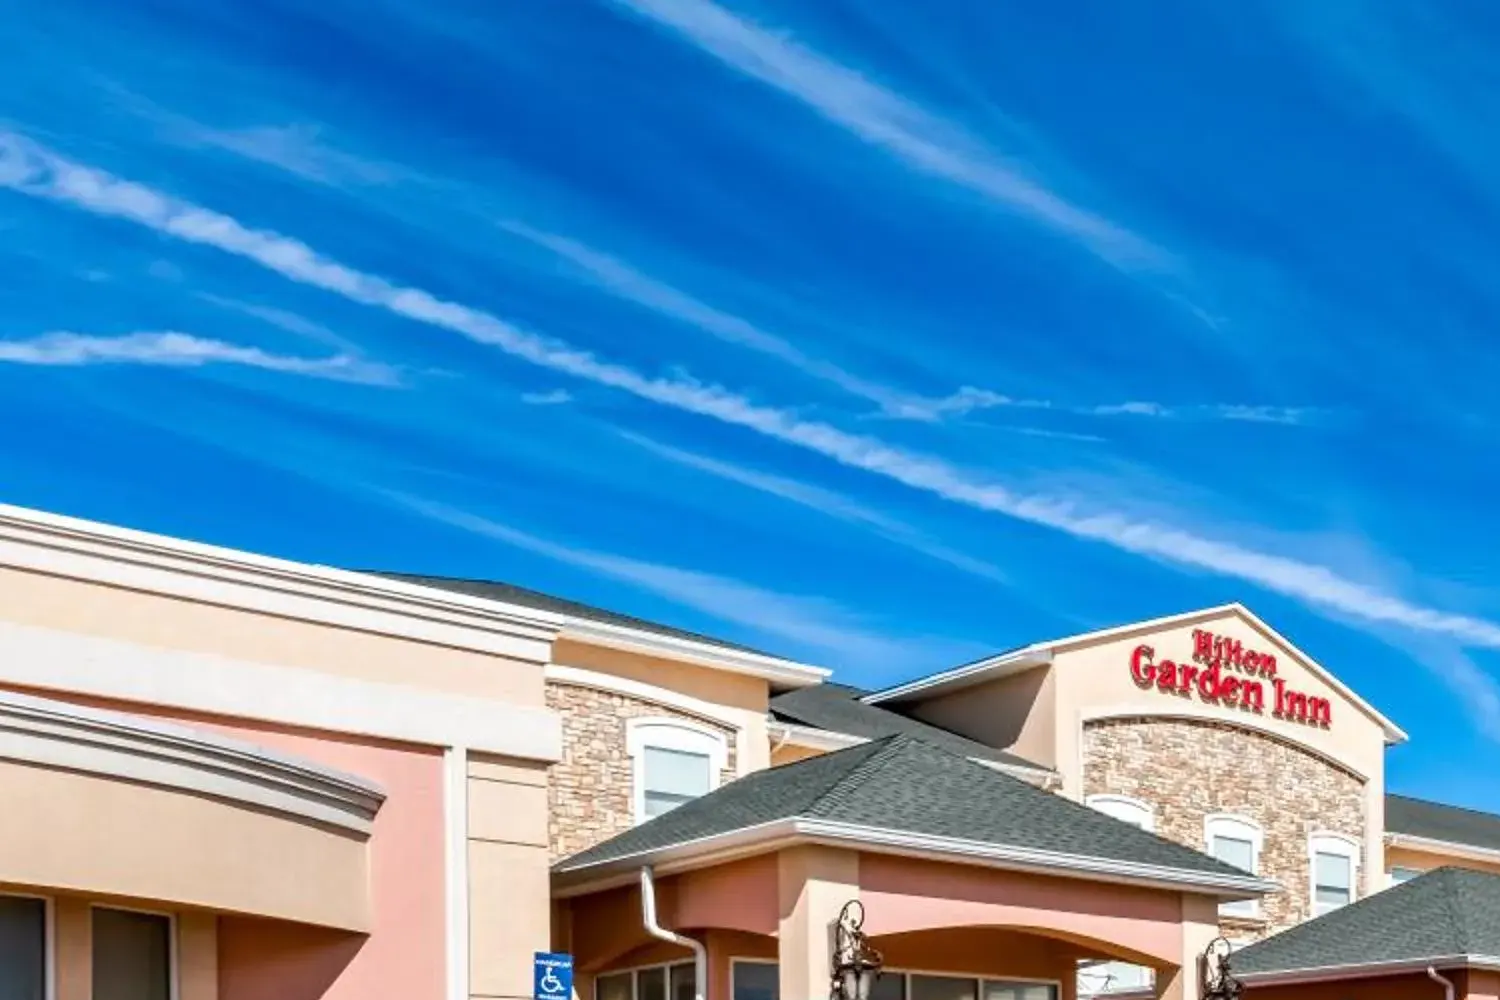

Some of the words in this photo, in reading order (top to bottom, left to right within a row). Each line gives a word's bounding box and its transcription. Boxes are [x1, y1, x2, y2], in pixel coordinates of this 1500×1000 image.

[1192, 628, 1278, 676] Hilton
[1130, 644, 1265, 713] Garden
[1272, 678, 1332, 726] Inn
